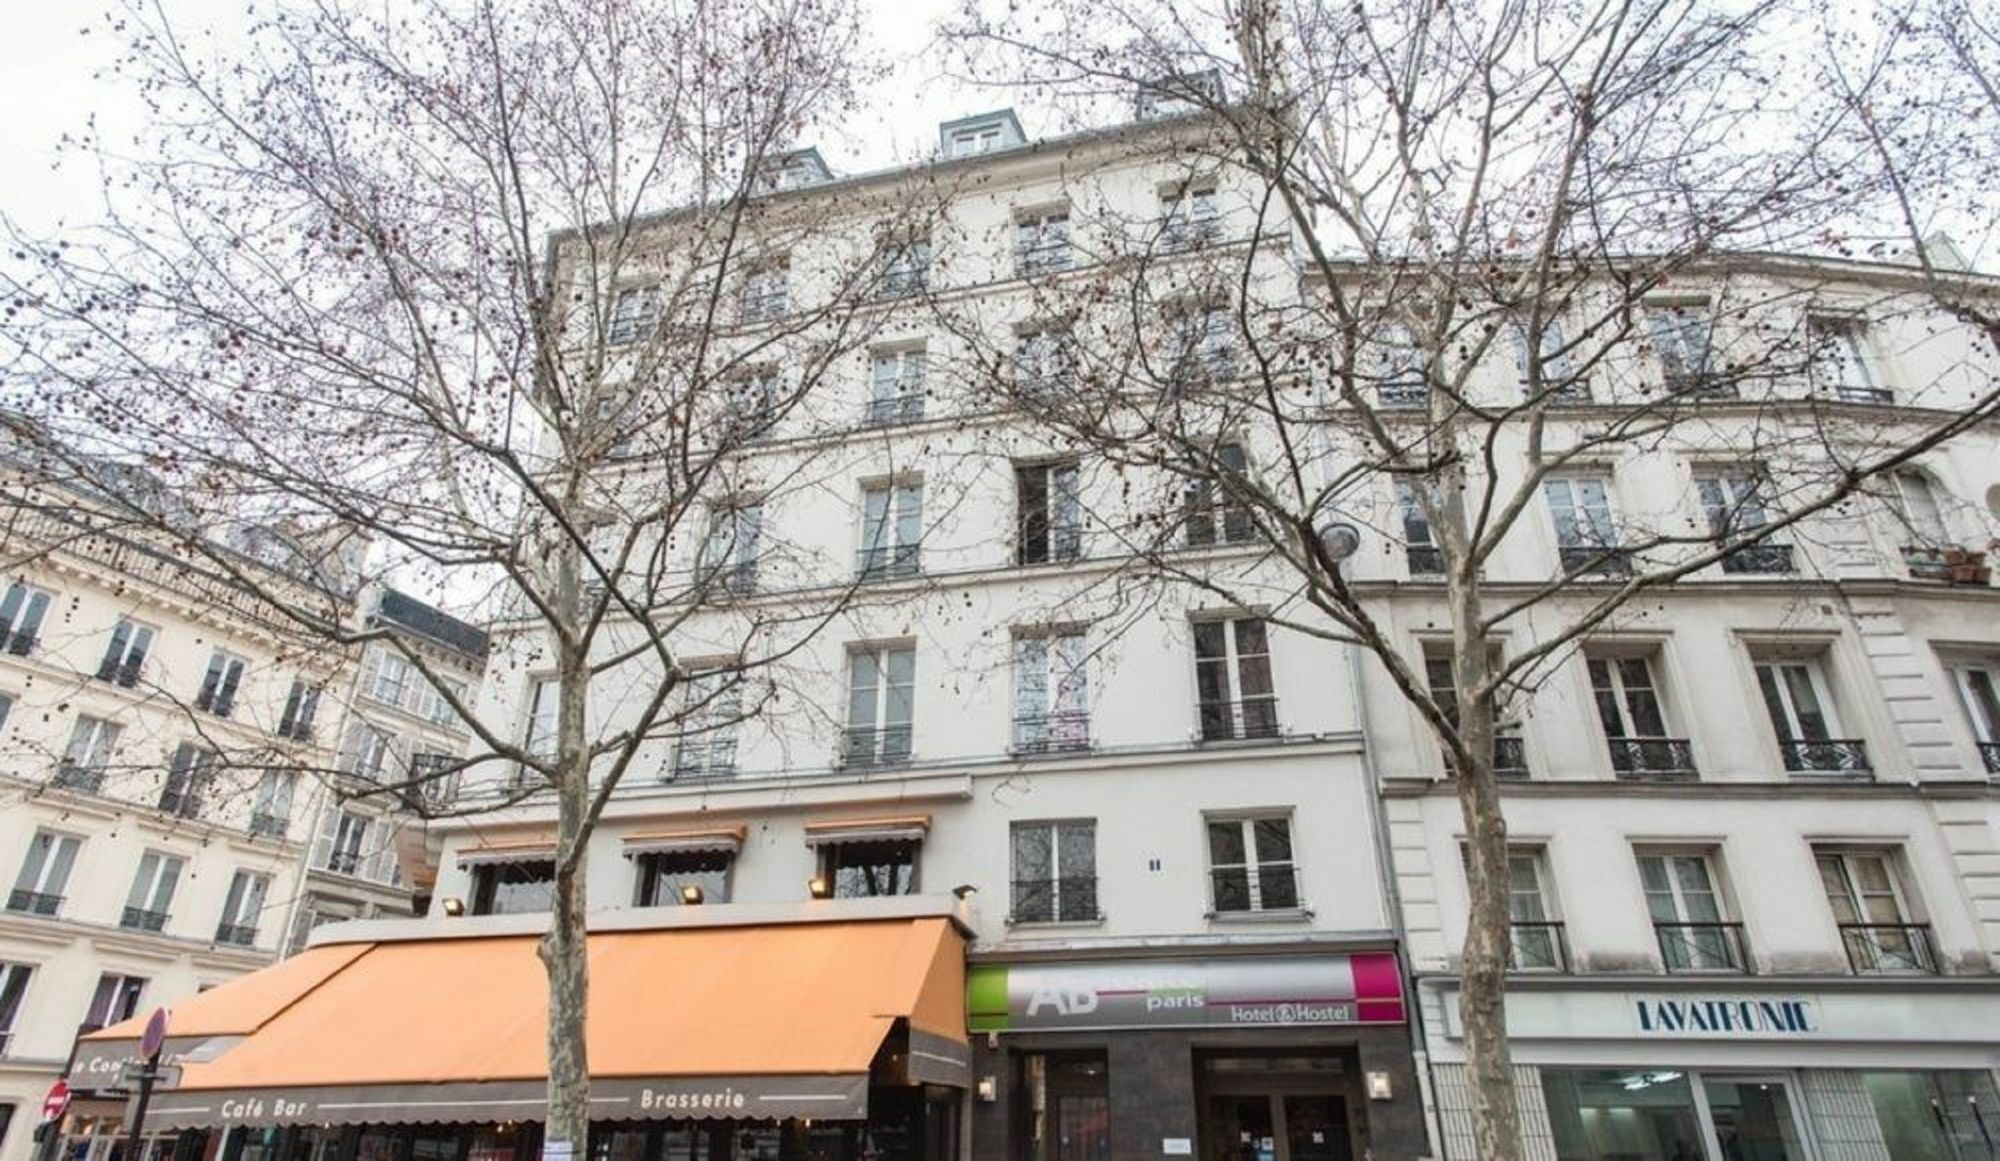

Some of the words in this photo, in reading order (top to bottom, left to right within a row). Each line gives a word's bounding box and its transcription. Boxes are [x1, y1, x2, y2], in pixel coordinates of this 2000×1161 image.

[1147, 991, 1205, 1012] paris
[1231, 1005, 1274, 1022] Hotel
[1297, 1004, 1350, 1021] Hostel
[1637, 1000, 1819, 1032] LAVATRONIC
[222, 1098, 264, 1118] Café
[274, 1098, 307, 1116] Bar
[641, 1087, 745, 1109] Brasserie
